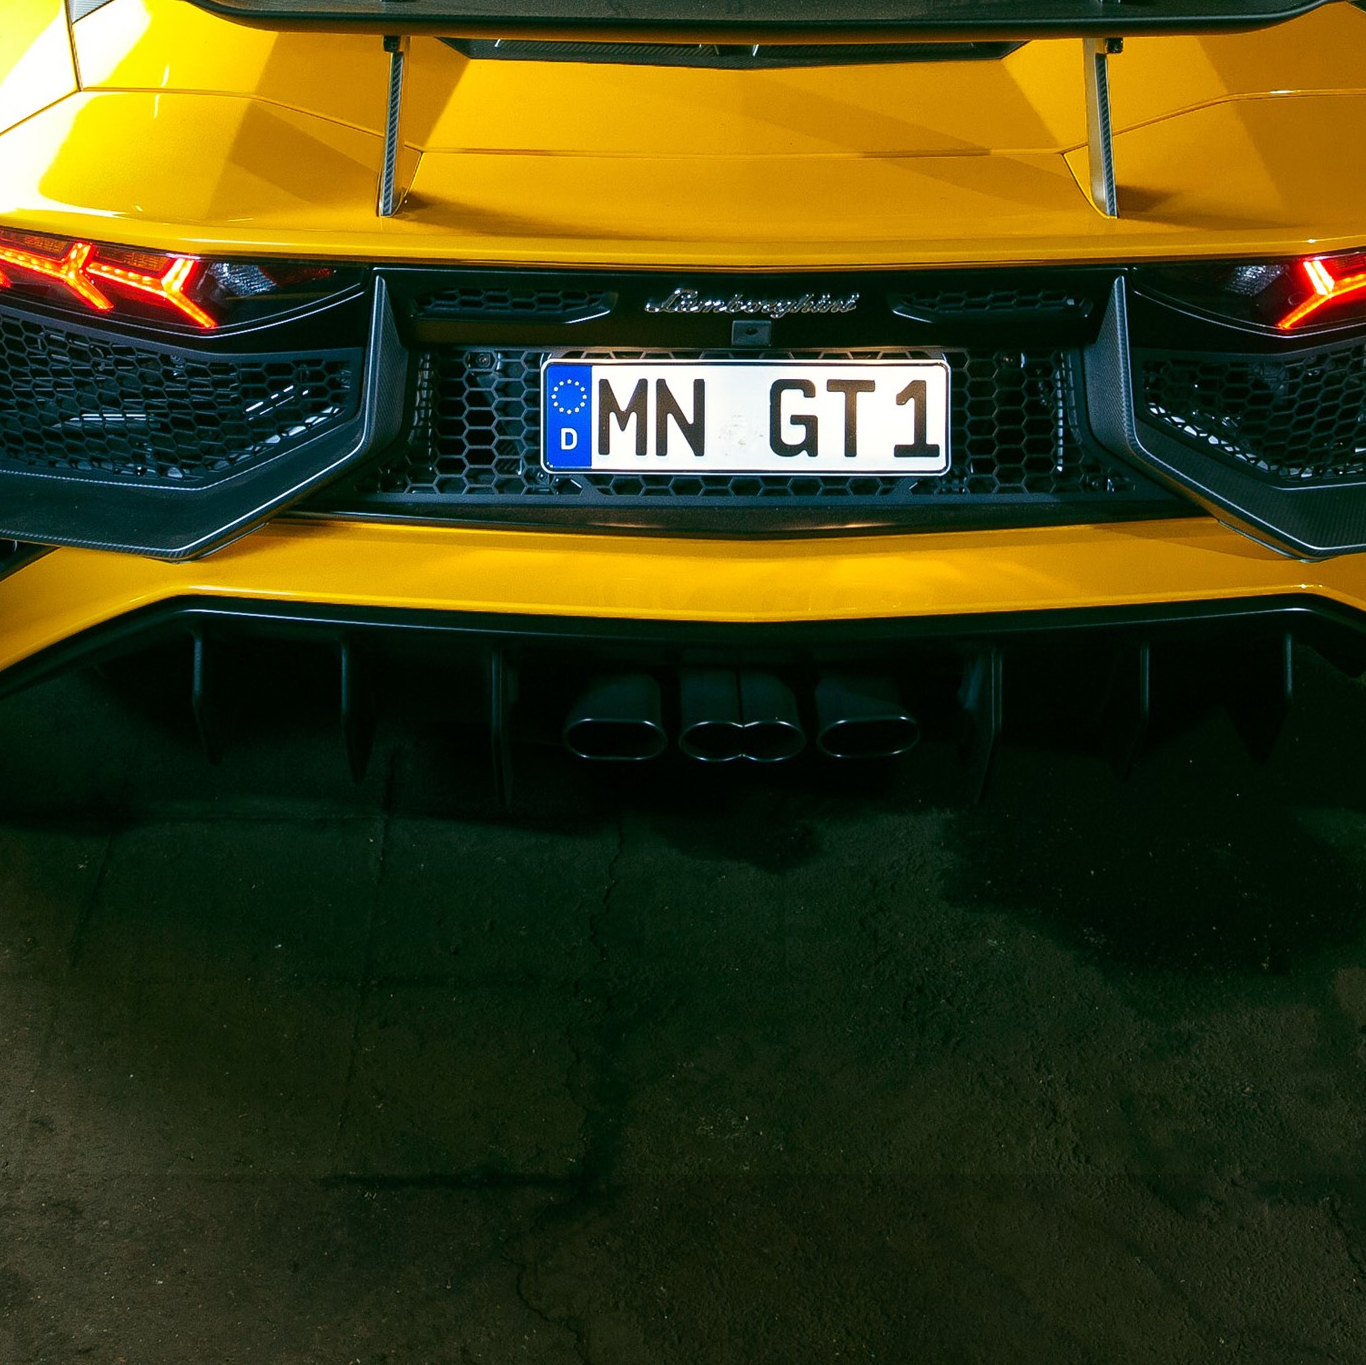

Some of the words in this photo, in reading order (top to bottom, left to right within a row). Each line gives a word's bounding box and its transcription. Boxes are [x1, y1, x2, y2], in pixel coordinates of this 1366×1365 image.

[644, 287, 860, 319] Lamborghini
[598, 378, 705, 456] MN
[560, 428, 578, 450] D
